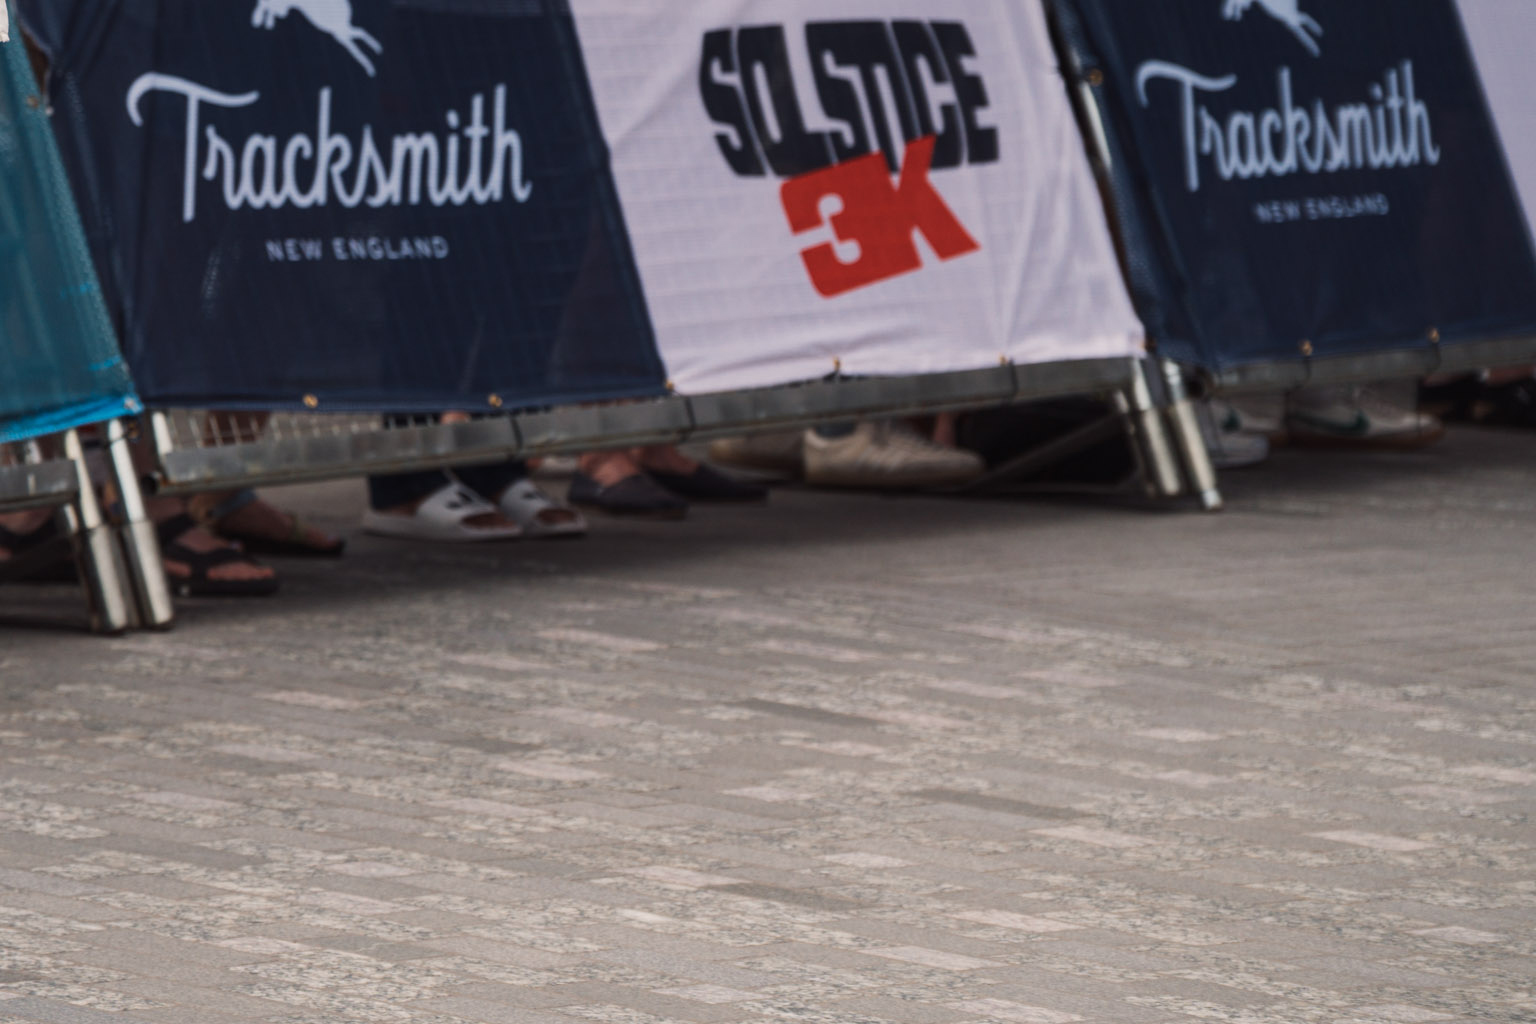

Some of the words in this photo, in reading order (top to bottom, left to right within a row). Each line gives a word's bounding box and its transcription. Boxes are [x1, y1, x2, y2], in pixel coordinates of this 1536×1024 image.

[126, 72, 532, 222] Tracksmith
[699, 19, 999, 178] SOLSTICE
[1137, 59, 1440, 192] Tracksmith
[265, 238, 323, 262] NEW
[335, 236, 450, 261] ENGLAND
[780, 133, 981, 299] 3K
[1253, 202, 1301, 224] NEW
[1305, 193, 1390, 220] ENGLAND
